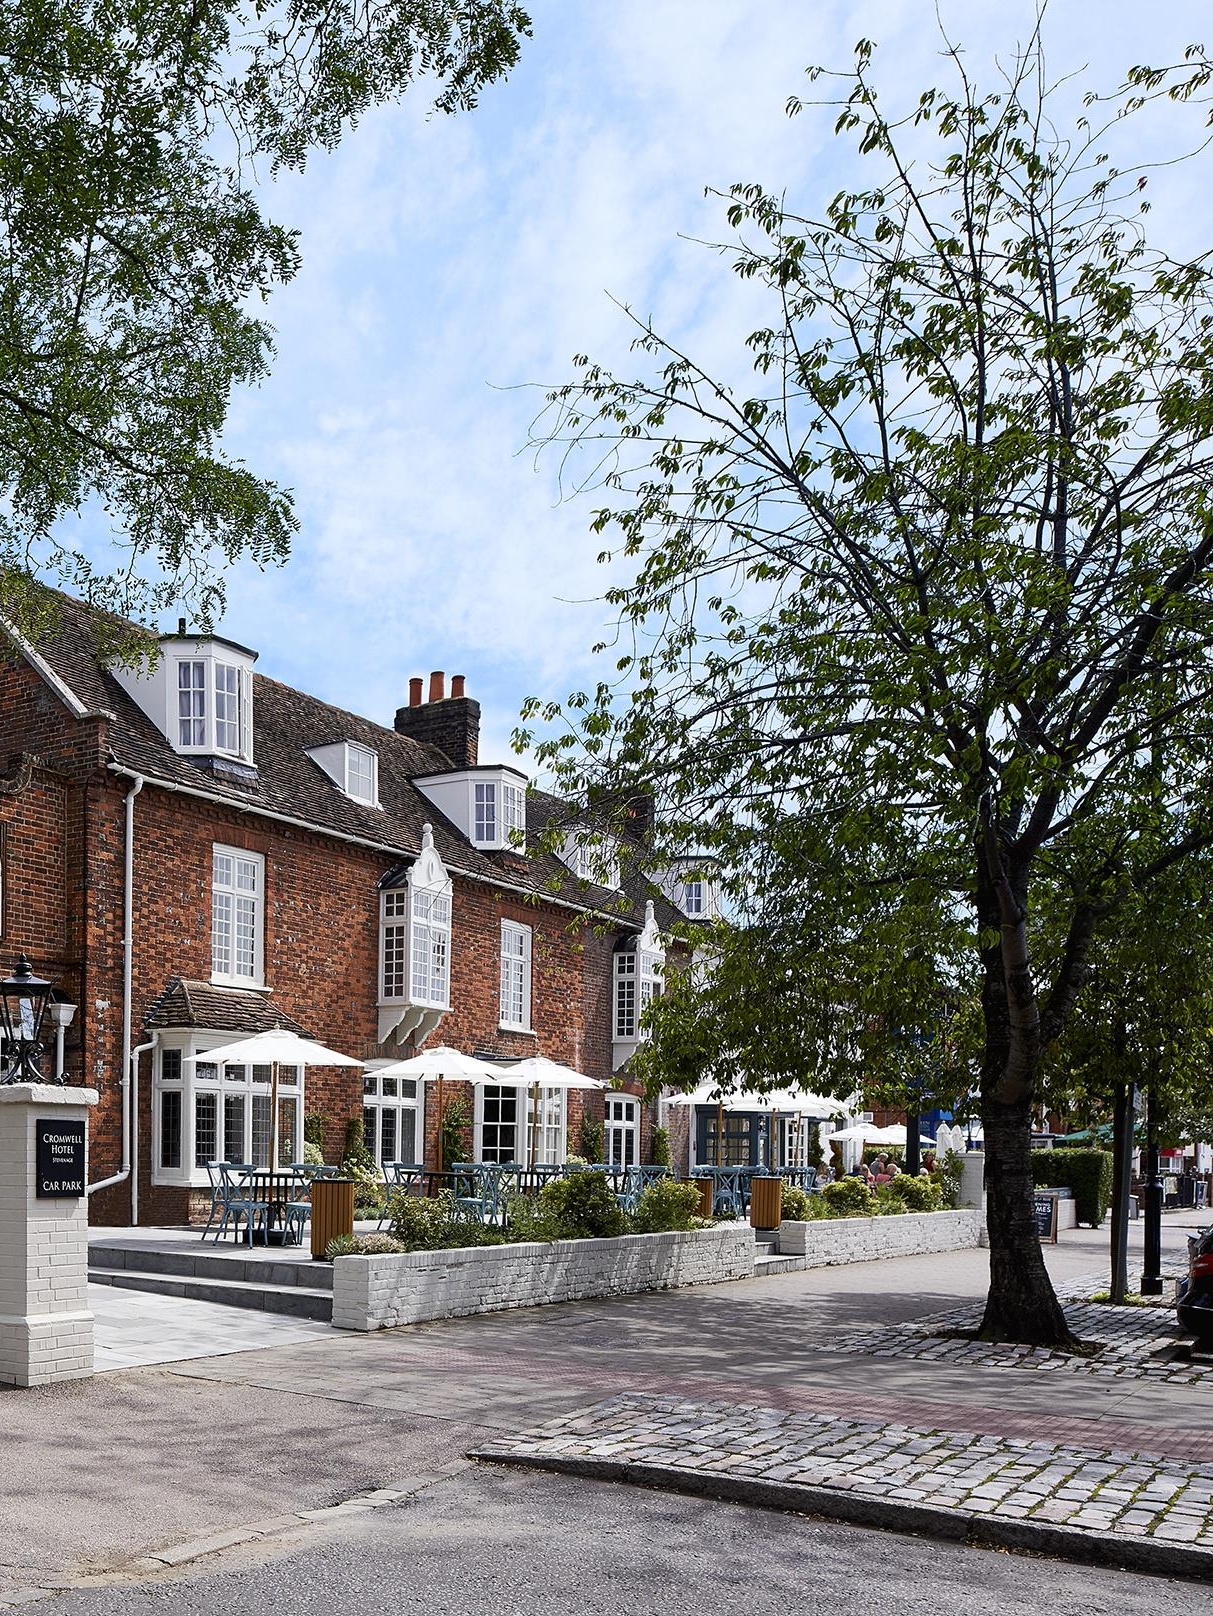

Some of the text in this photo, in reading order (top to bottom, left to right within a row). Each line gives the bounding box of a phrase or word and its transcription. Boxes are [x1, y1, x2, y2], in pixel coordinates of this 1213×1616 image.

[43, 1133, 82, 1144] CROMWELL
[51, 1144, 75, 1154] HOTEL
[43, 1181, 82, 1191] CAR PARK
